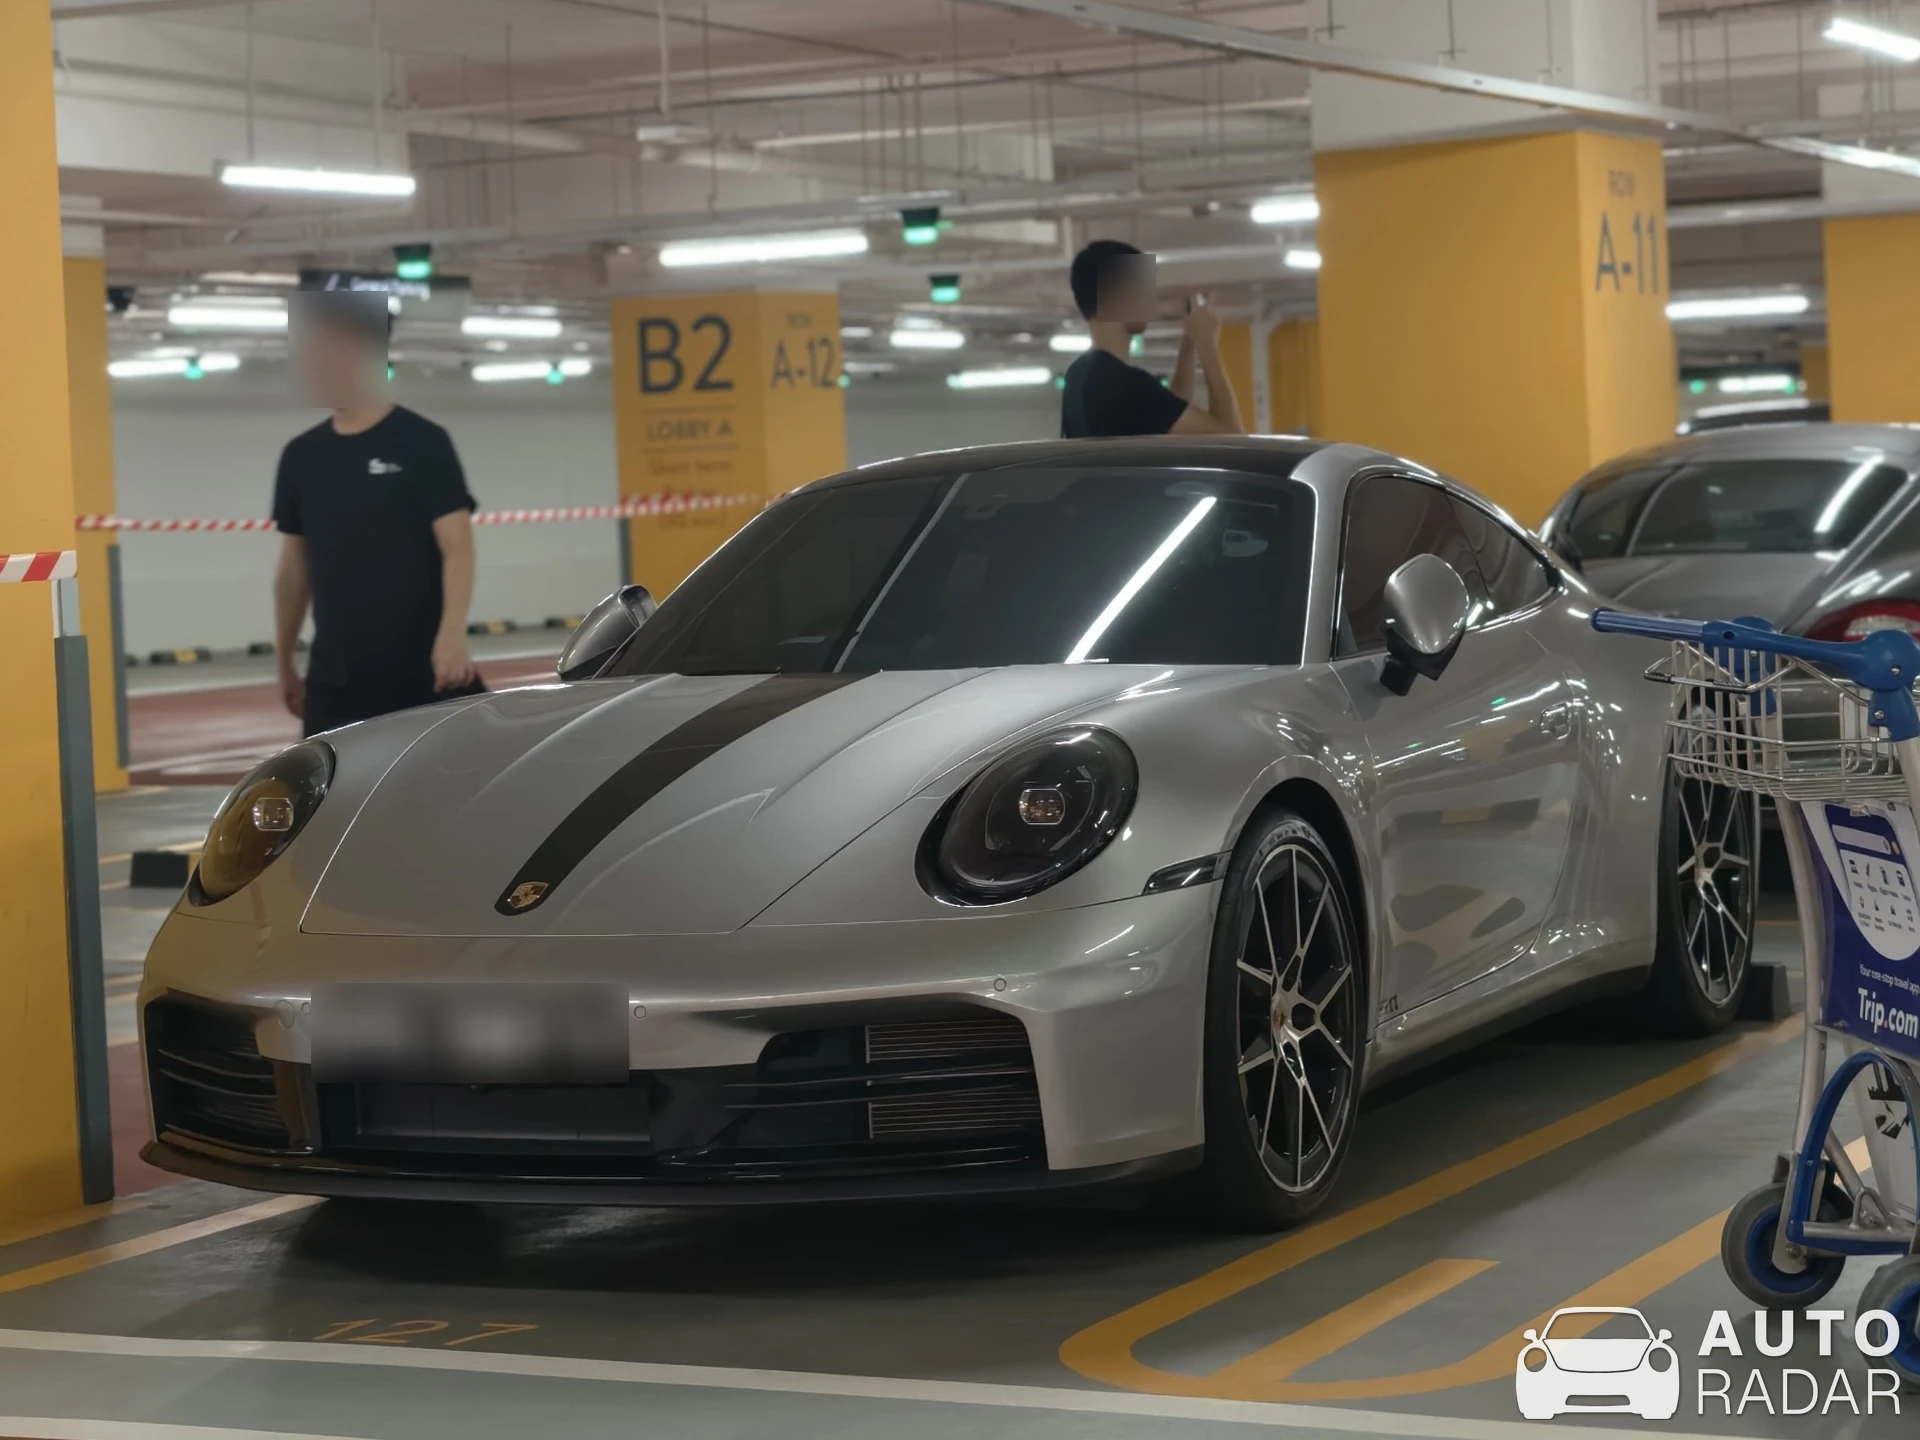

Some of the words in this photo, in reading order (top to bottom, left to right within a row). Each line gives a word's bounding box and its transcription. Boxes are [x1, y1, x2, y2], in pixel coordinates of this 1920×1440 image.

[1608, 169, 1636, 197] ROW
[1595, 209, 1658, 294] A-11
[637, 313, 734, 394] B2
[771, 335, 836, 391] A-12
[646, 419, 711, 442] LOBBY
[716, 417, 734, 437] A
[1859, 963, 1872, 977] Your
[1871, 970, 1894, 988] one-stop
[1894, 976, 1909, 991] travel
[1857, 986, 1919, 1039] Trip.com
[312, 1317, 540, 1347] 127
